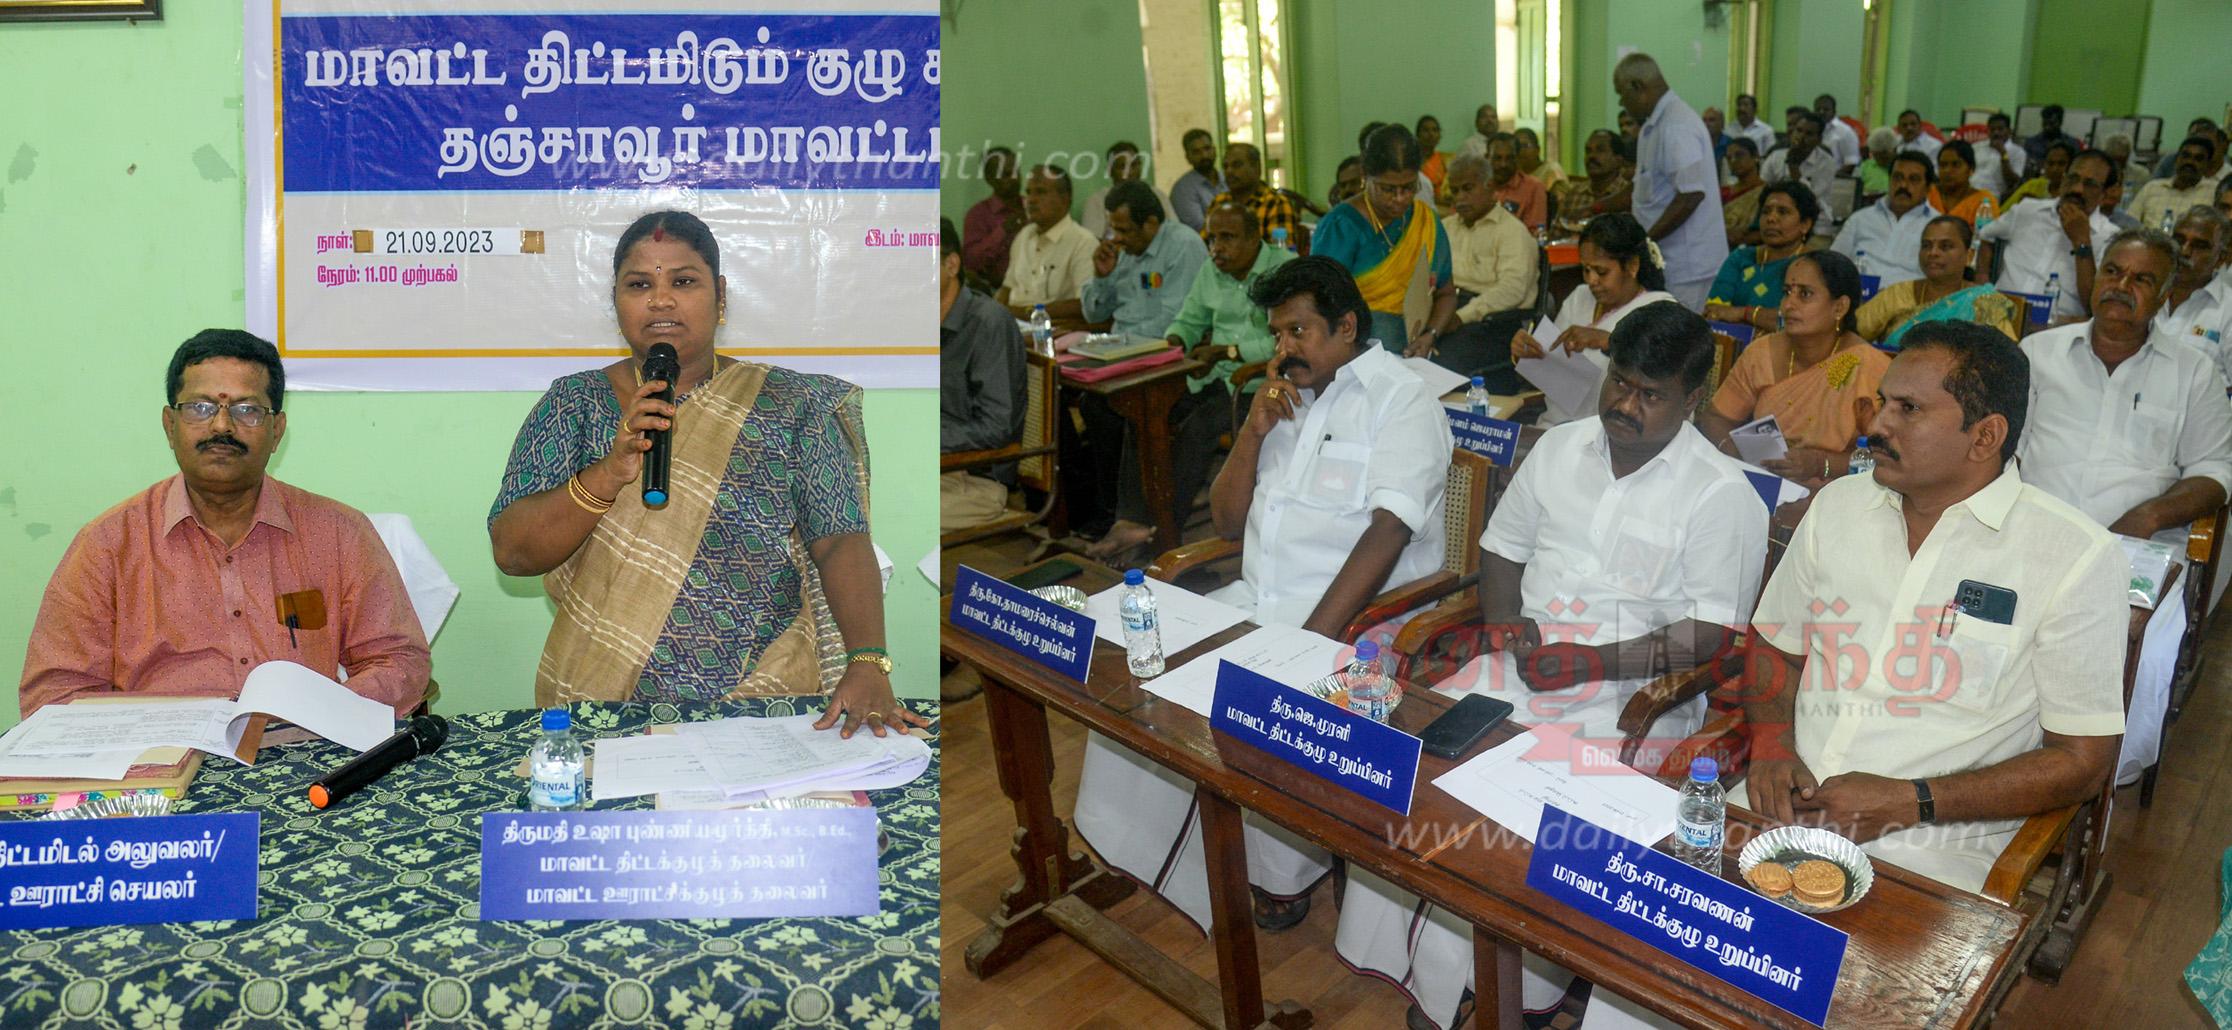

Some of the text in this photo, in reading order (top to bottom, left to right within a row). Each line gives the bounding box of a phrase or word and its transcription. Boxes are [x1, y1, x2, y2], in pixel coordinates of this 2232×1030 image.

[304, 42, 506, 88] மாவட்ட
[522, 25, 790, 98] திட்டமிடும்
[806, 43, 906, 103] குழு
[437, 103, 709, 184] தஞ்சாவூர்
[386, 230, 494, 254] 21.09.2023
[317, 263, 459, 288] நேரம்: 11.00 முற்பகல்
[1270, 694, 1352, 743] திரு.ஜெ.முரளி
[1226, 705, 1394, 790] மாவட்ட திட்டக்குழு உறுப்பினர்
[105, 829, 226, 869] அலுவலர்/
[502, 819, 569, 846] திருமதி
[573, 823, 622, 845] உஷா
[540, 853, 612, 873] மாவட்ட
[9, 870, 197, 909] ஊராட்சி செயலர்
[526, 885, 599, 905] மாவட்ட
[1605, 852, 1756, 933] திரு.சா.சரவணன்
[1552, 863, 1803, 993] மாவட்ட திட்டக்குழு உறுப்பினர்
